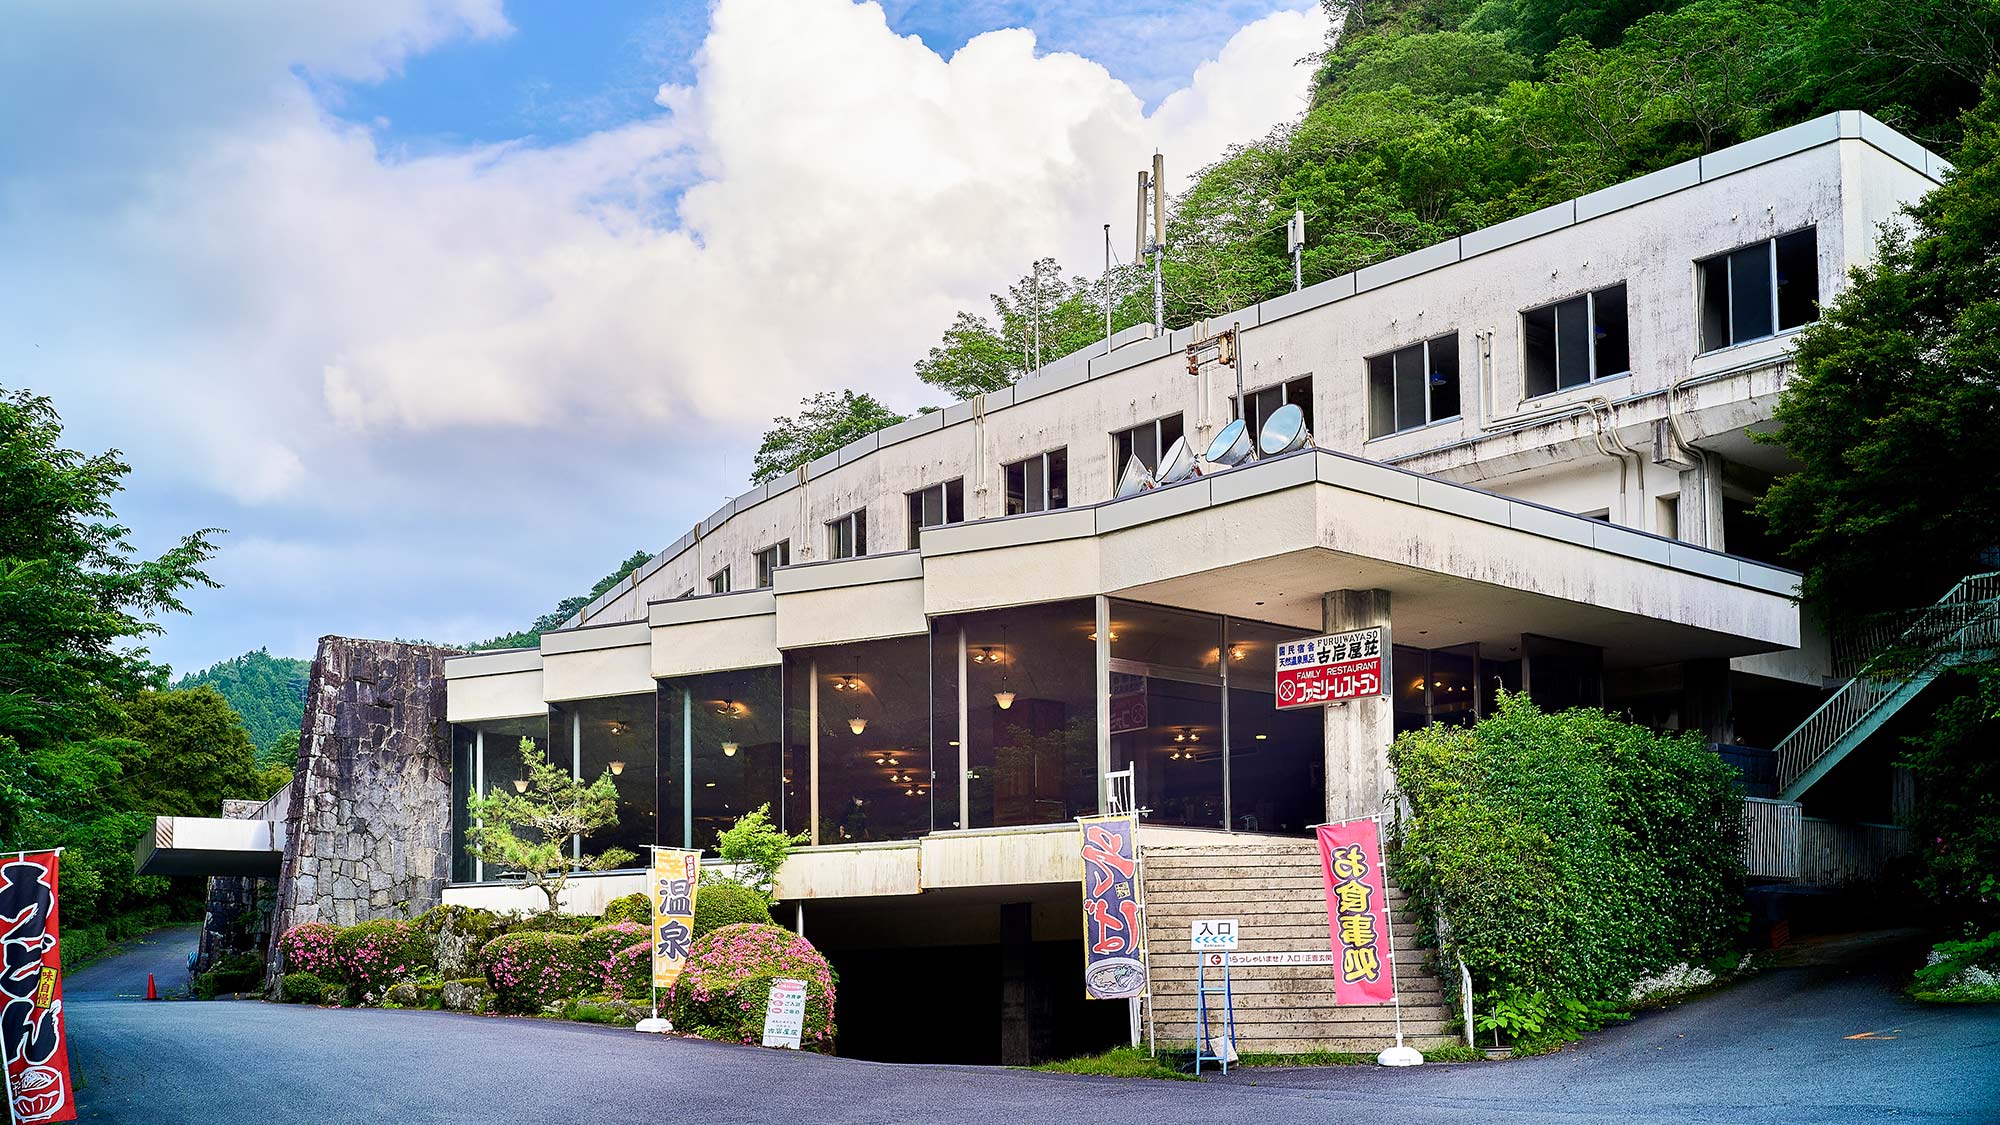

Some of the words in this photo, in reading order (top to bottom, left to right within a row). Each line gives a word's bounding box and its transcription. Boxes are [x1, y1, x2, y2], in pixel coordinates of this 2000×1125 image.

[1317, 630, 1378, 647] FURUIWAYASO
[1317, 640, 1379, 664] 古岩屋荘
[1297, 669, 1321, 680] FAMILY
[1327, 661, 1378, 676] RESTAURANT
[1296, 673, 1379, 703] ファミリーレストラン
[657, 878, 692, 960] 温泉
[1199, 922, 1231, 936] 入口
[37, 970, 53, 1006] 味自慢
